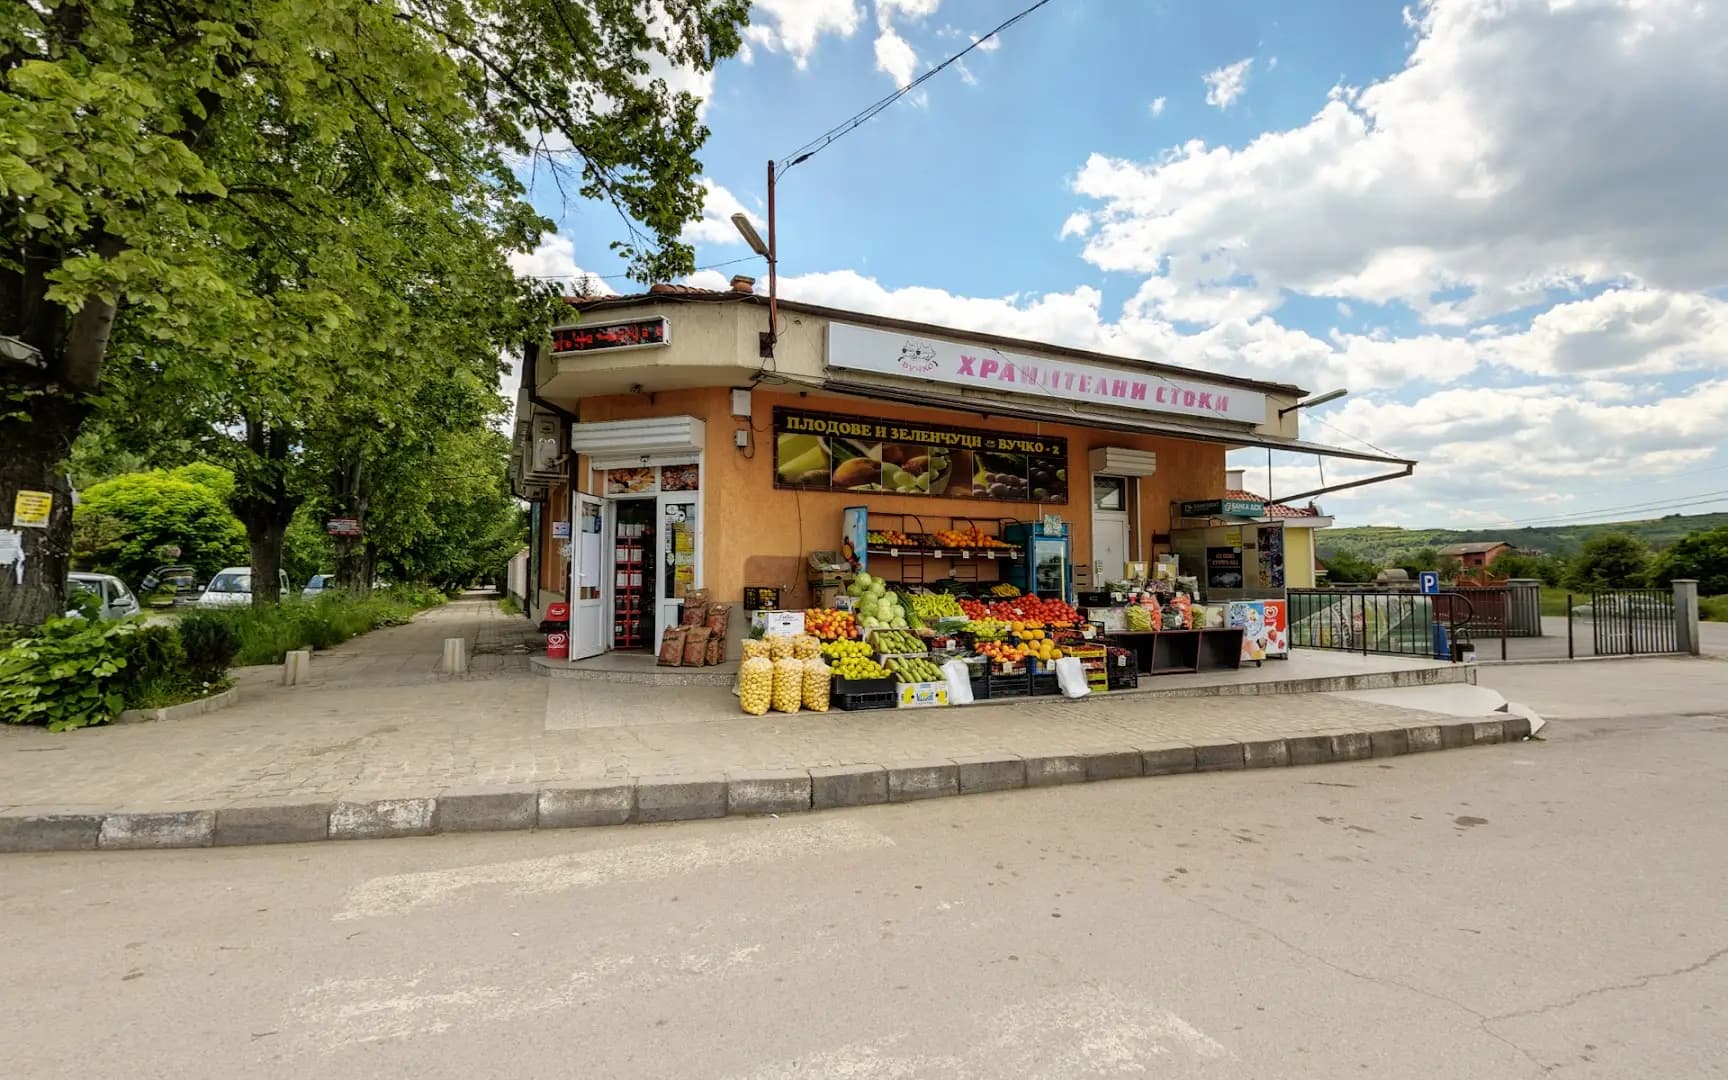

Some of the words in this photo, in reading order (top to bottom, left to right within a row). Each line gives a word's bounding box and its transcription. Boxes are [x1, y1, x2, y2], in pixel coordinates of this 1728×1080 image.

[1156, 386, 1230, 412] СТОКИ
[787, 416, 872, 436] ПЛОДОВЕ
[876, 425, 887, 438] И
[890, 427, 982, 448] ЗЕЛЕНЧУЦИ
[998, 438, 1044, 453] ВУЧКО
[1052, 445, 1060, 455] 2
[1424, 575, 1434, 593] P
